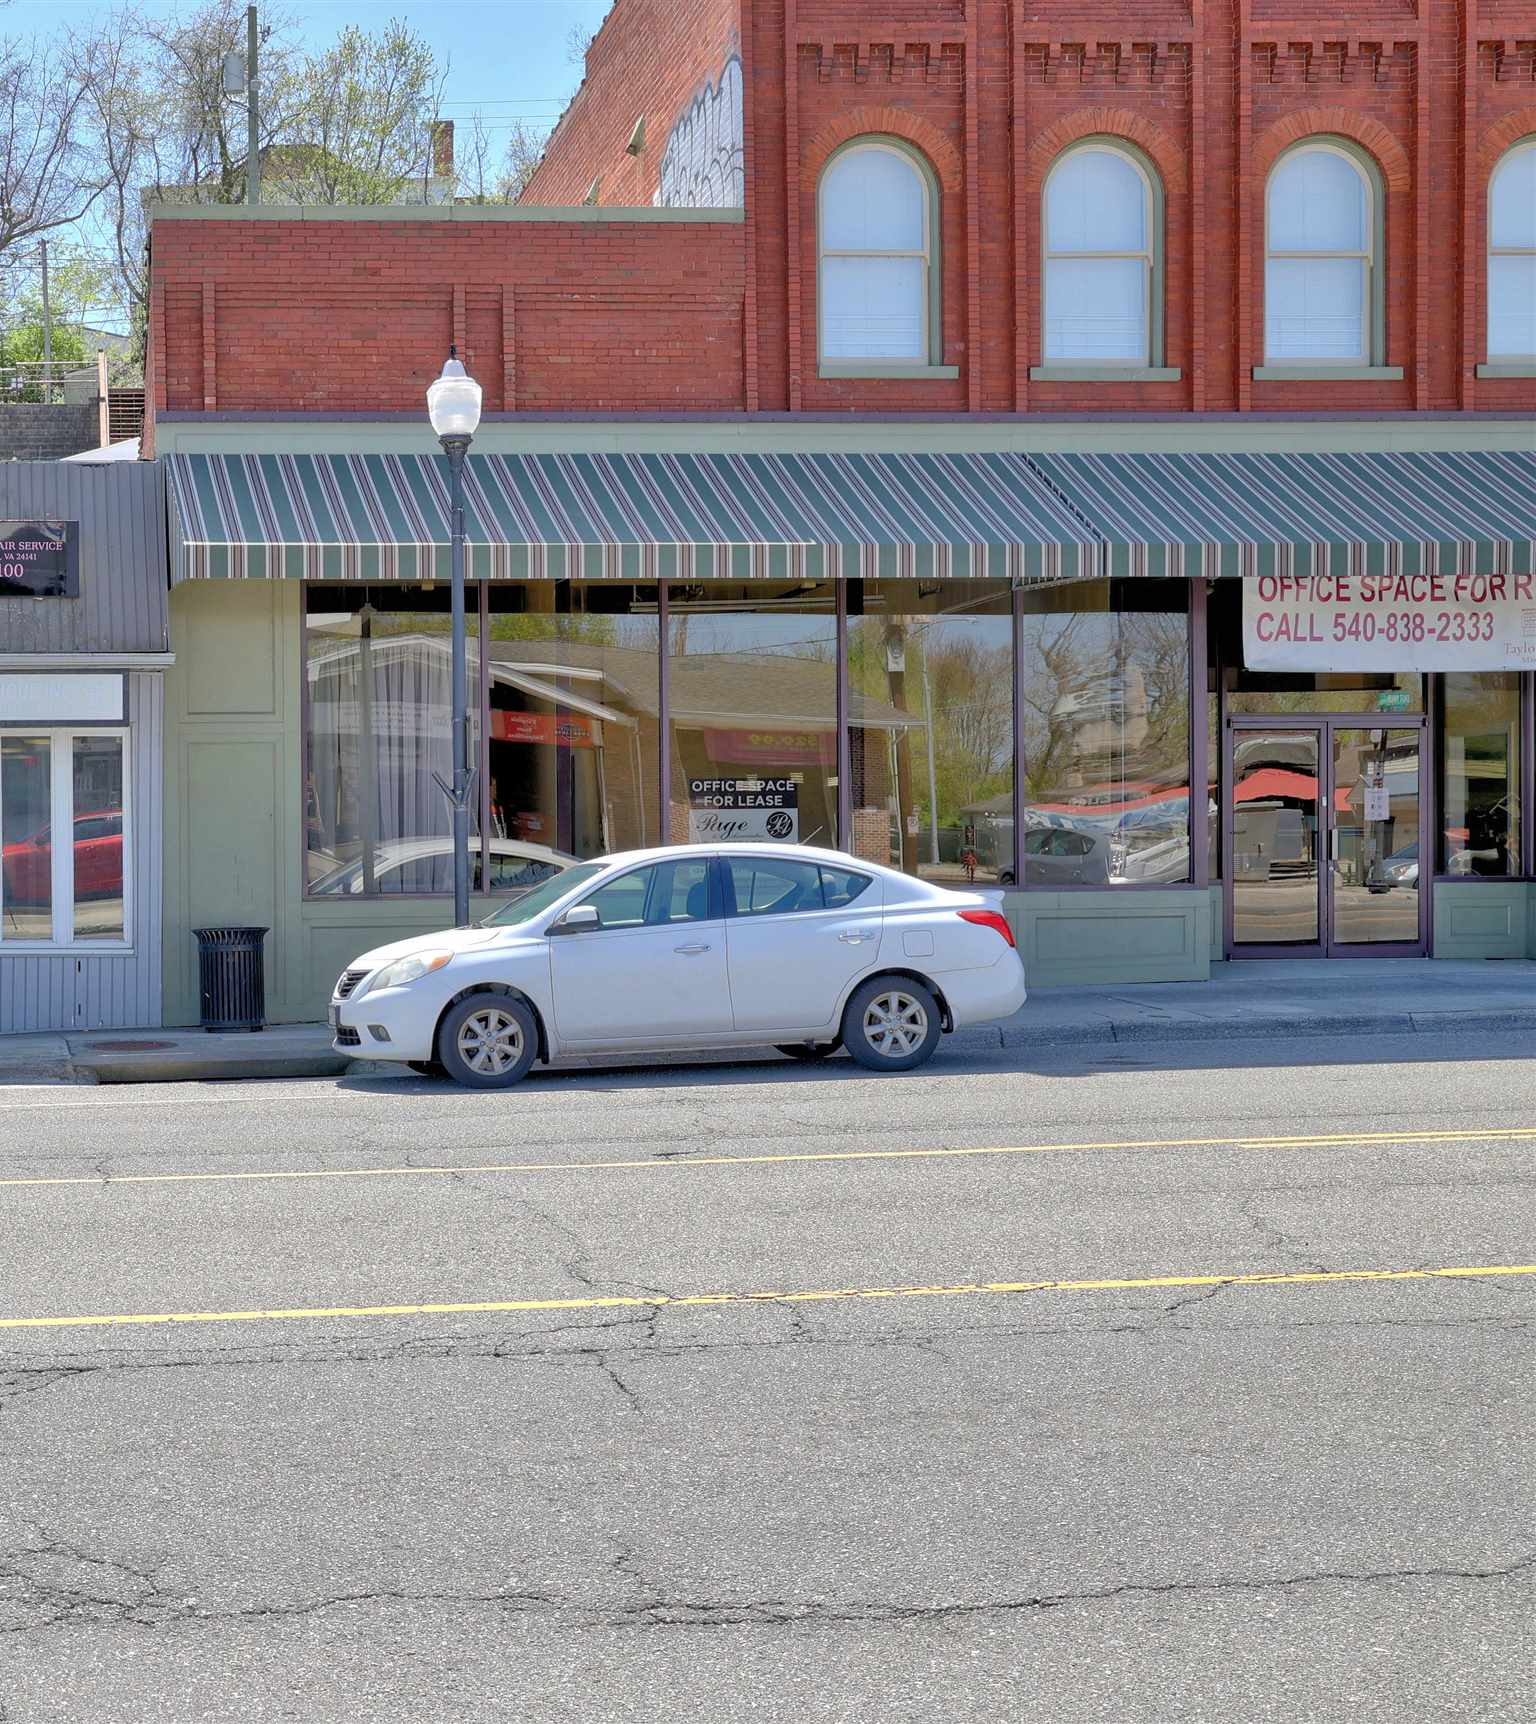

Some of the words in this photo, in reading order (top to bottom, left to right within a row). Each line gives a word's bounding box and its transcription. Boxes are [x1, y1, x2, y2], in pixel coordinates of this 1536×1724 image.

[18, 541, 63, 551] SERVICE
[1258, 576, 1352, 602] OFFICE
[1360, 576, 1447, 602] SPACE
[1454, 576, 1507, 602] FOR
[1256, 612, 1324, 641] CALL
[1332, 612, 1494, 641] 540-838-2333
[692, 781, 745, 792] OFFICE
[705, 796, 733, 806] FOR
[738, 796, 783, 806] LEASE
[696, 813, 748, 840] Page
